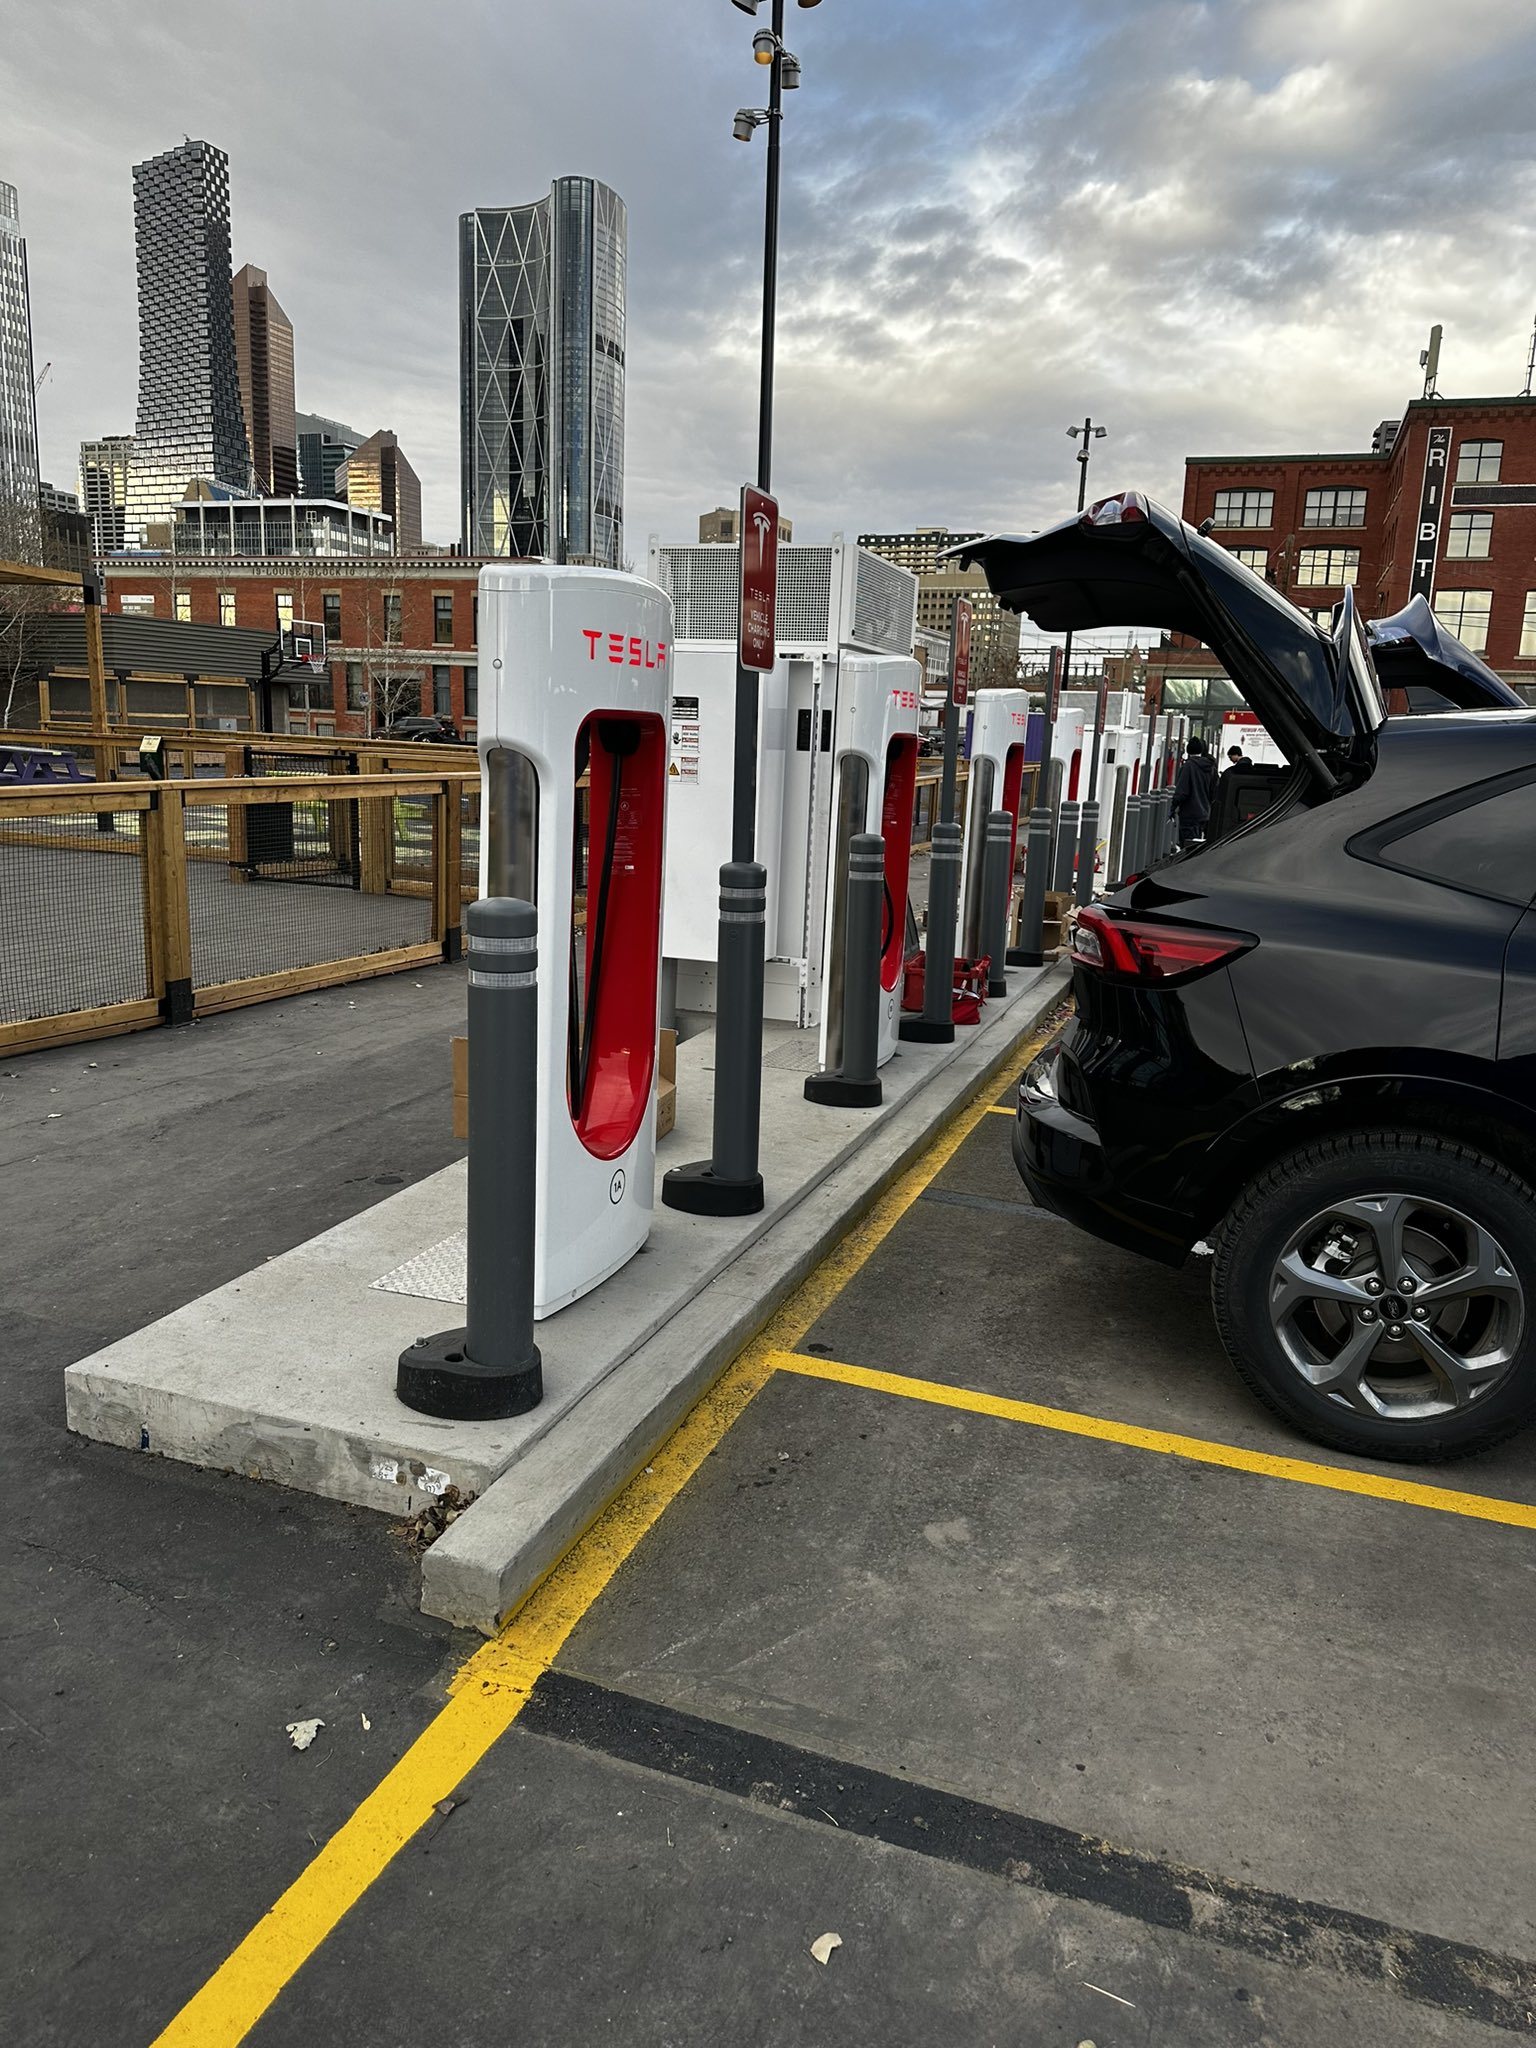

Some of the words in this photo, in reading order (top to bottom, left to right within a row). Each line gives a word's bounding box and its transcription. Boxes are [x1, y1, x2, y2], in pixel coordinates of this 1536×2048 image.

[252, 567, 261, 576] 19
[266, 567, 302, 576] LOUISE
[308, 568, 342, 576] BLOCK
[749, 587, 770, 603] TESLA
[750, 609, 769, 625] VEHICLE
[748, 622, 770, 638] CHARGING
[582, 629, 666, 670] TESLA
[753, 637, 765, 650] ONLY
[892, 690, 919, 709] TESL
